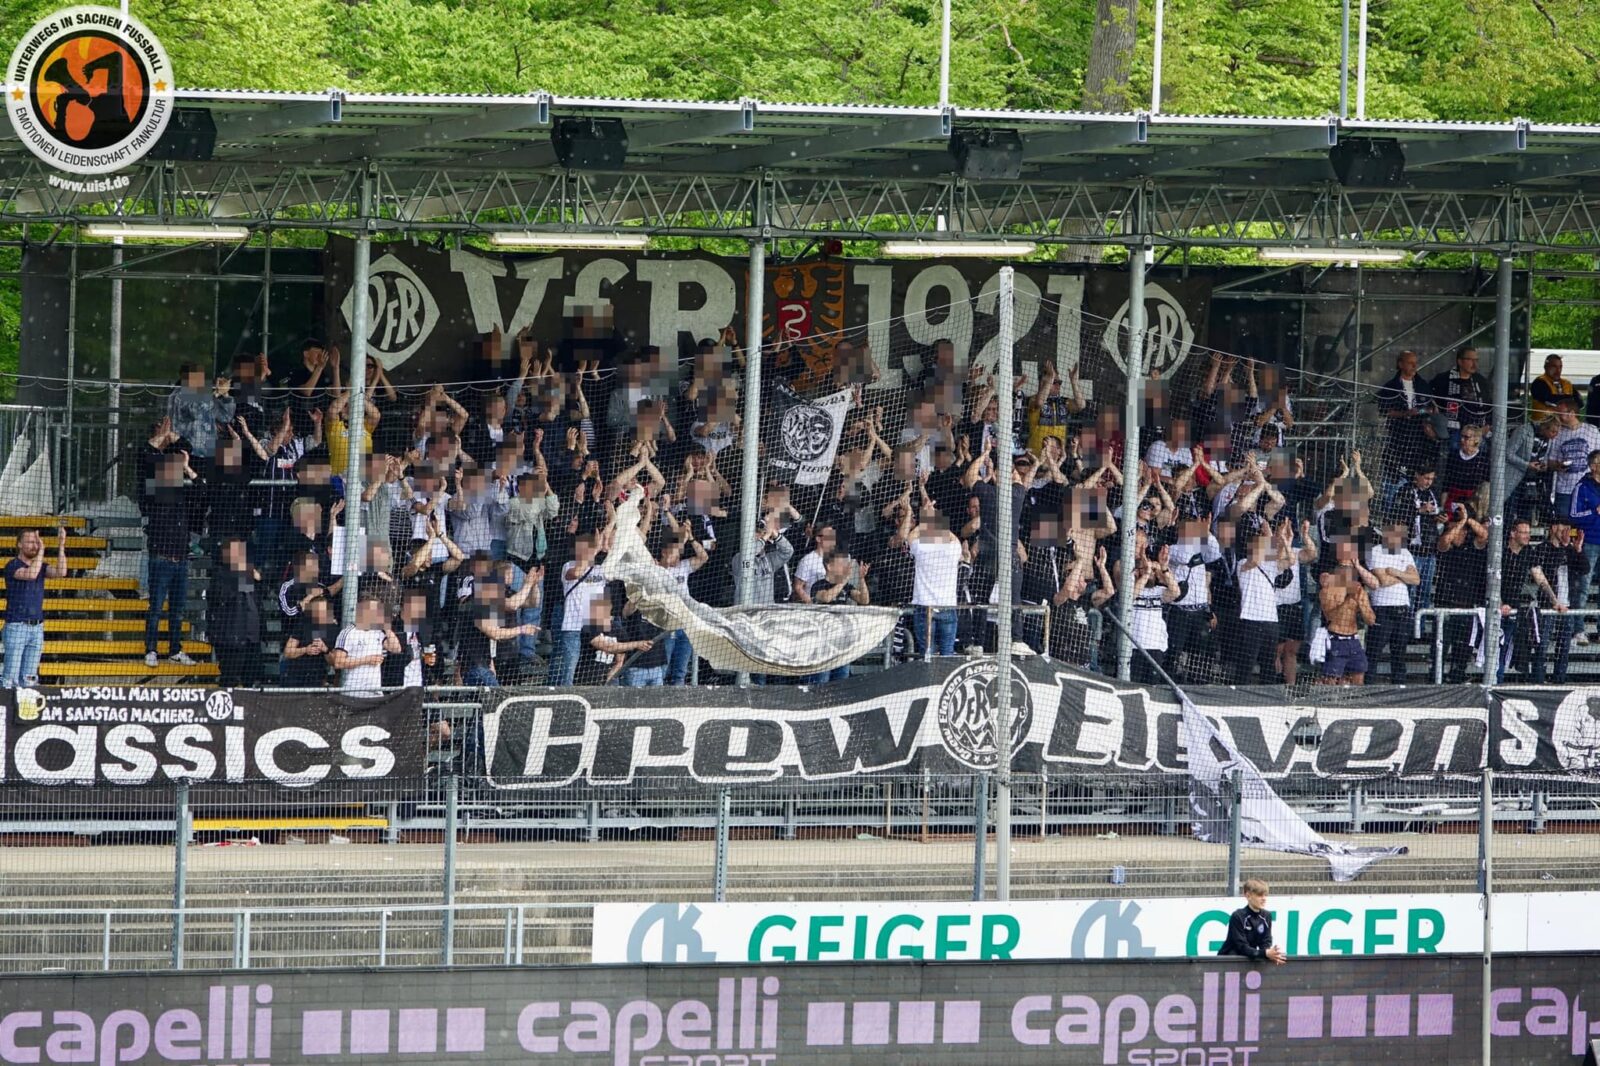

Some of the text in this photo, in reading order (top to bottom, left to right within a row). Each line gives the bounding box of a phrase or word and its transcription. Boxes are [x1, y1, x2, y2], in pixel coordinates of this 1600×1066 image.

[449, 249, 1094, 401] VfR 1921
[41, 706, 208, 723] AM SAMSTAG MACHEN?...
[92, 687, 126, 701] SOLL
[128, 687, 160, 701] MAN
[162, 688, 206, 702] SONST
[489, 694, 934, 789] Crew
[748, 914, 1022, 961] GEIGER
[1186, 908, 1446, 957] GIGER
[0, 983, 274, 1066] capelli
[517, 975, 779, 1066] capelli
[1011, 972, 1260, 1065] capelli
